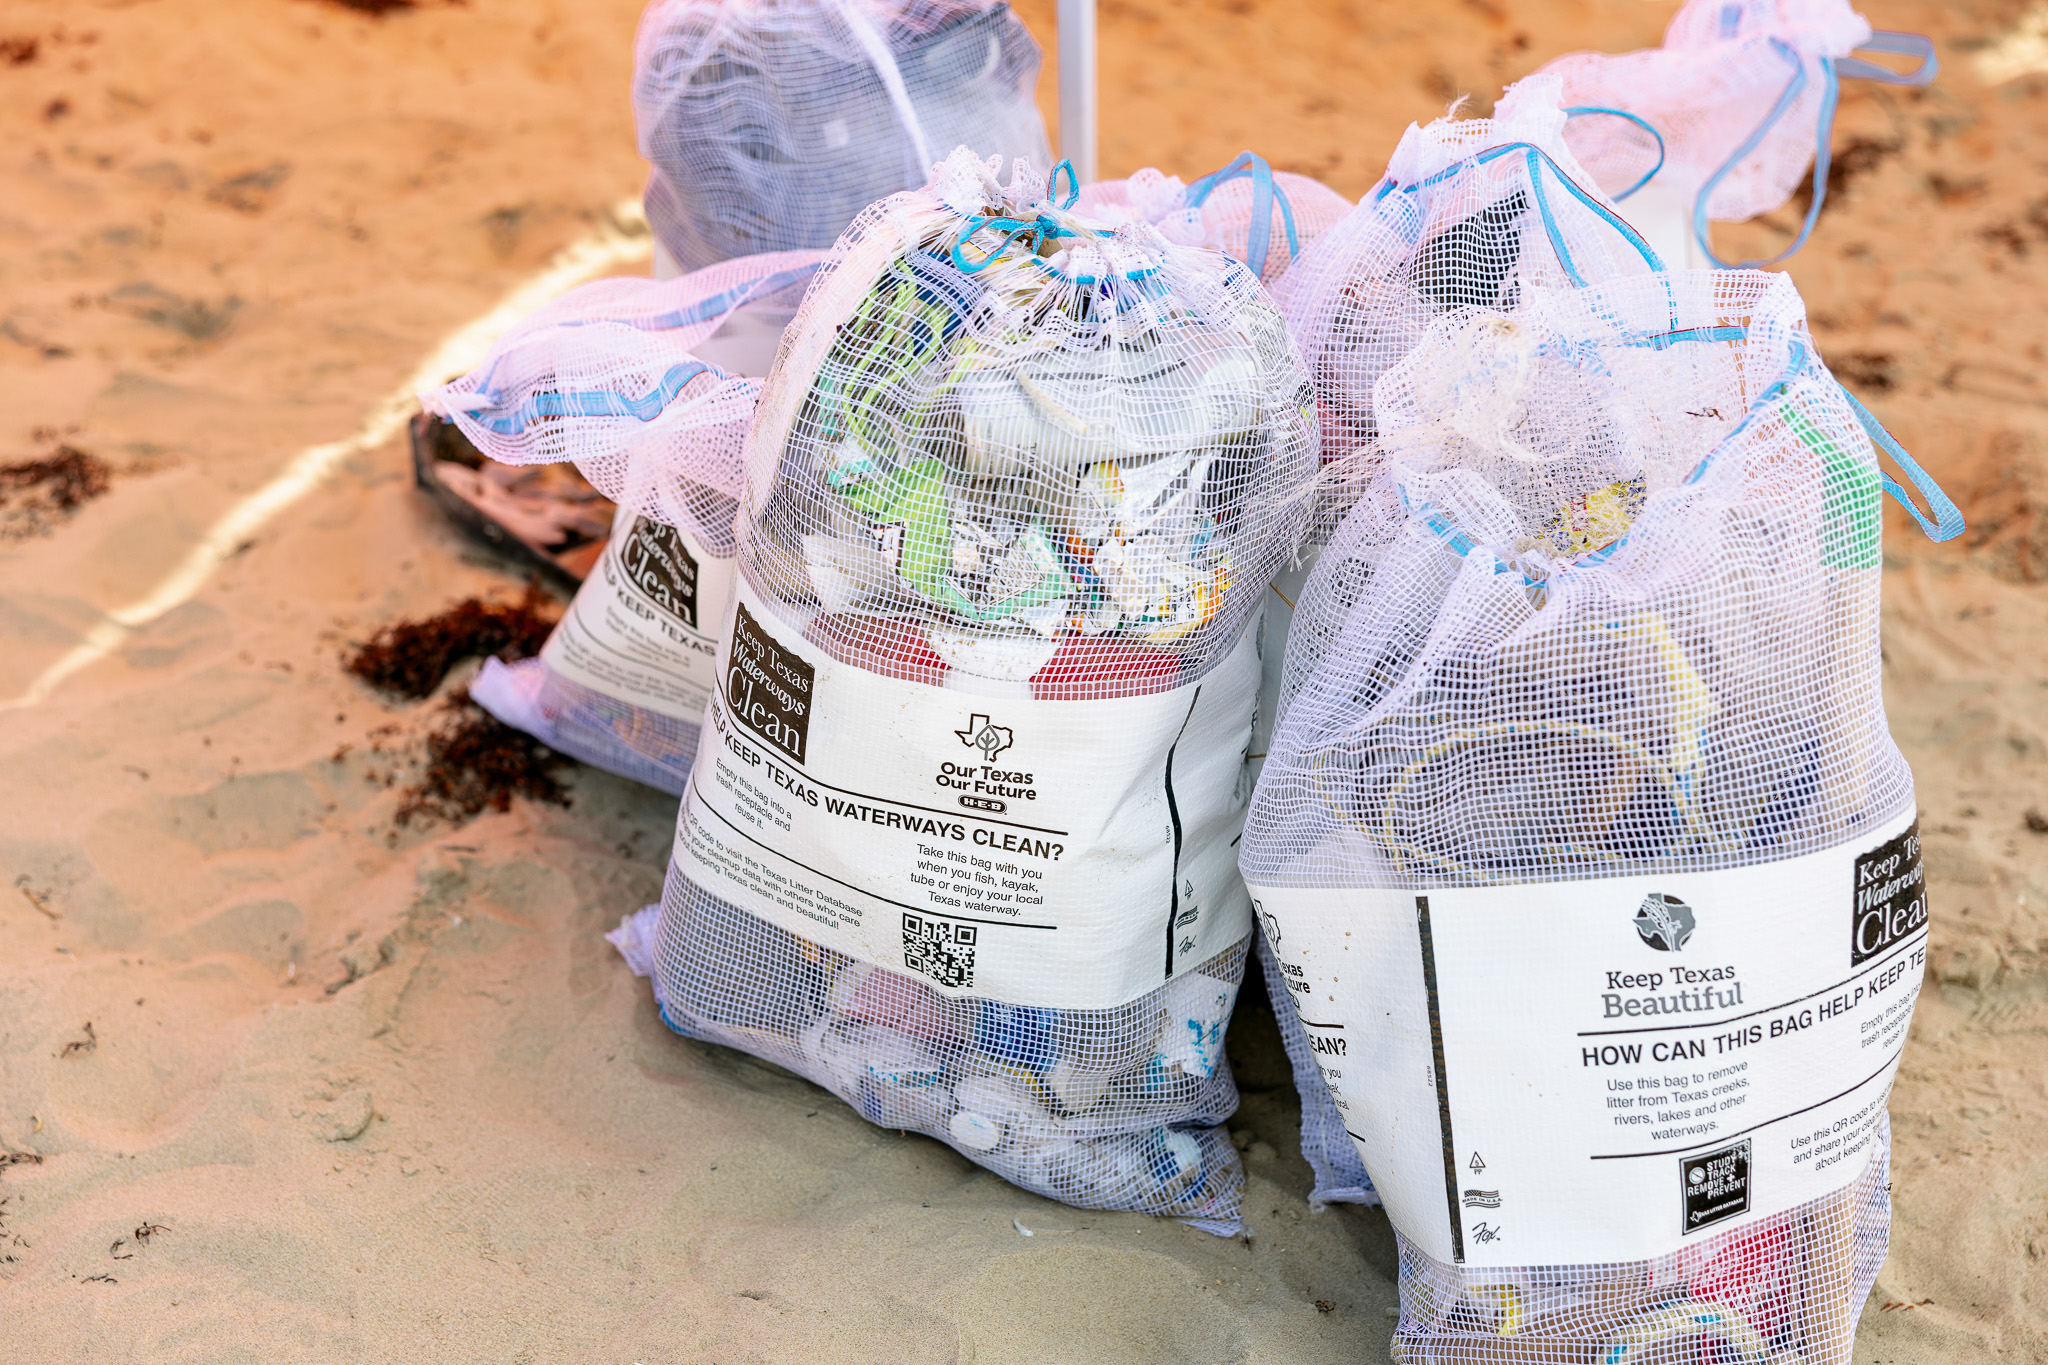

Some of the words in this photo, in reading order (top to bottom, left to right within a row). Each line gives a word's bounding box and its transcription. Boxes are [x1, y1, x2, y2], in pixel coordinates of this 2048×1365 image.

[624, 533, 694, 625] Clean
[616, 587, 656, 621] KEEP
[660, 618, 717, 657] TEXAS
[737, 613, 765, 662] Keep
[768, 645, 809, 693] Texas
[733, 637, 806, 716] Waterways
[728, 666, 802, 757] Clean
[716, 757, 738, 783] Empty
[739, 776, 753, 793] this
[754, 786, 769, 806] bag
[770, 797, 785, 815] into
[786, 811, 793, 820] a
[936, 774, 970, 791] Our
[974, 780, 1037, 800] Future
[940, 761, 977, 778] Our
[980, 764, 1034, 785] Texas
[724, 730, 761, 768] KEEP
[765, 761, 819, 808] TEXAS
[825, 795, 966, 841] WATERWAYS
[972, 829, 1064, 861] CLEAN?
[734, 788, 773, 821] receptacle
[774, 817, 791, 832] and
[734, 803, 755, 824] reuse
[756, 817, 764, 830] it.
[691, 832, 706, 851] your
[707, 847, 741, 872] cleanup
[742, 866, 761, 883] data
[763, 878, 782, 893] with
[783, 888, 814, 907] others
[816, 902, 837, 917] who
[839, 912, 861, 927] care
[697, 825, 715, 845] code
[716, 839, 724, 851] to
[725, 846, 743, 862] visit
[744, 856, 759, 870] the
[761, 863, 787, 885] Texas
[789, 878, 814, 896] Litter
[816, 889, 863, 917] Database
[916, 843, 944, 859] Take
[947, 849, 968, 864] this
[970, 854, 992, 872] bag
[995, 860, 1018, 875] with
[1021, 869, 1043, 880] you
[917, 858, 948, 875] when
[950, 868, 972, 881] you
[974, 870, 998, 887] fish,
[1001, 877, 1039, 894] kayak,
[1858, 854, 1900, 887] Keep
[691, 845, 720, 874] keeping
[722, 865, 748, 887] Texas
[750, 883, 774, 901] clean
[776, 896, 794, 910] and
[796, 904, 839, 930] beautiful!
[910, 872, 935, 887] tube
[938, 879, 951, 890] or
[953, 883, 984, 899] enjoy
[986, 892, 1012, 904] your
[1015, 893, 1043, 905] local
[927, 890, 961, 908] Texas
[964, 900, 1022, 917] waterway.
[1606, 971, 1663, 991] Keep
[1669, 965, 1735, 985] Texas
[1582, 1043, 1643, 1067] HOW
[1652, 1038, 1706, 1062] CAN
[1712, 1025, 1762, 1055] THIS
[1769, 1010, 1813, 1039] BAG
[1818, 986, 1865, 1022] HELP
[1868, 960, 1906, 998] KEEP
[1601, 981, 1744, 1019] Beautiful
[1861, 1012, 1885, 1034] Empty
[1606, 1096, 1634, 1109] litter
[1638, 1094, 1668, 1107] from
[1671, 1088, 1709, 1104] Texas
[1711, 1077, 1750, 1097] creeks,
[1607, 1078, 1633, 1092] Use
[1637, 1076, 1660, 1089] this
[1664, 1075, 1689, 1088] bag
[1692, 1073, 1705, 1084] to
[1707, 1061, 1748, 1081] remove
[1614, 1113, 1654, 1126] rivers,
[1657, 1109, 1691, 1123] lakes
[1694, 1104, 1717, 1117] and
[1719, 1094, 1747, 1111] other
[1790, 1135, 1811, 1149] Use
[1813, 1127, 1831, 1142] this
[1832, 1117, 1848, 1133] QR
[1849, 1107, 1869, 1125] code
[1651, 1120, 1719, 1141] waterways.
[1793, 1148, 1812, 1164] and
[1814, 1138, 1841, 1156] share
[1842, 1127, 1861, 1146] your
[1706, 1154, 1737, 1172] STUDY
[1815, 1152, 1841, 1171] about
[1843, 1133, 1871, 1158] keeping
[1687, 1177, 1725, 1197] REMOVE
[1706, 1163, 1737, 1181] TRACK
[1707, 1177, 1746, 1200] PREVENT
